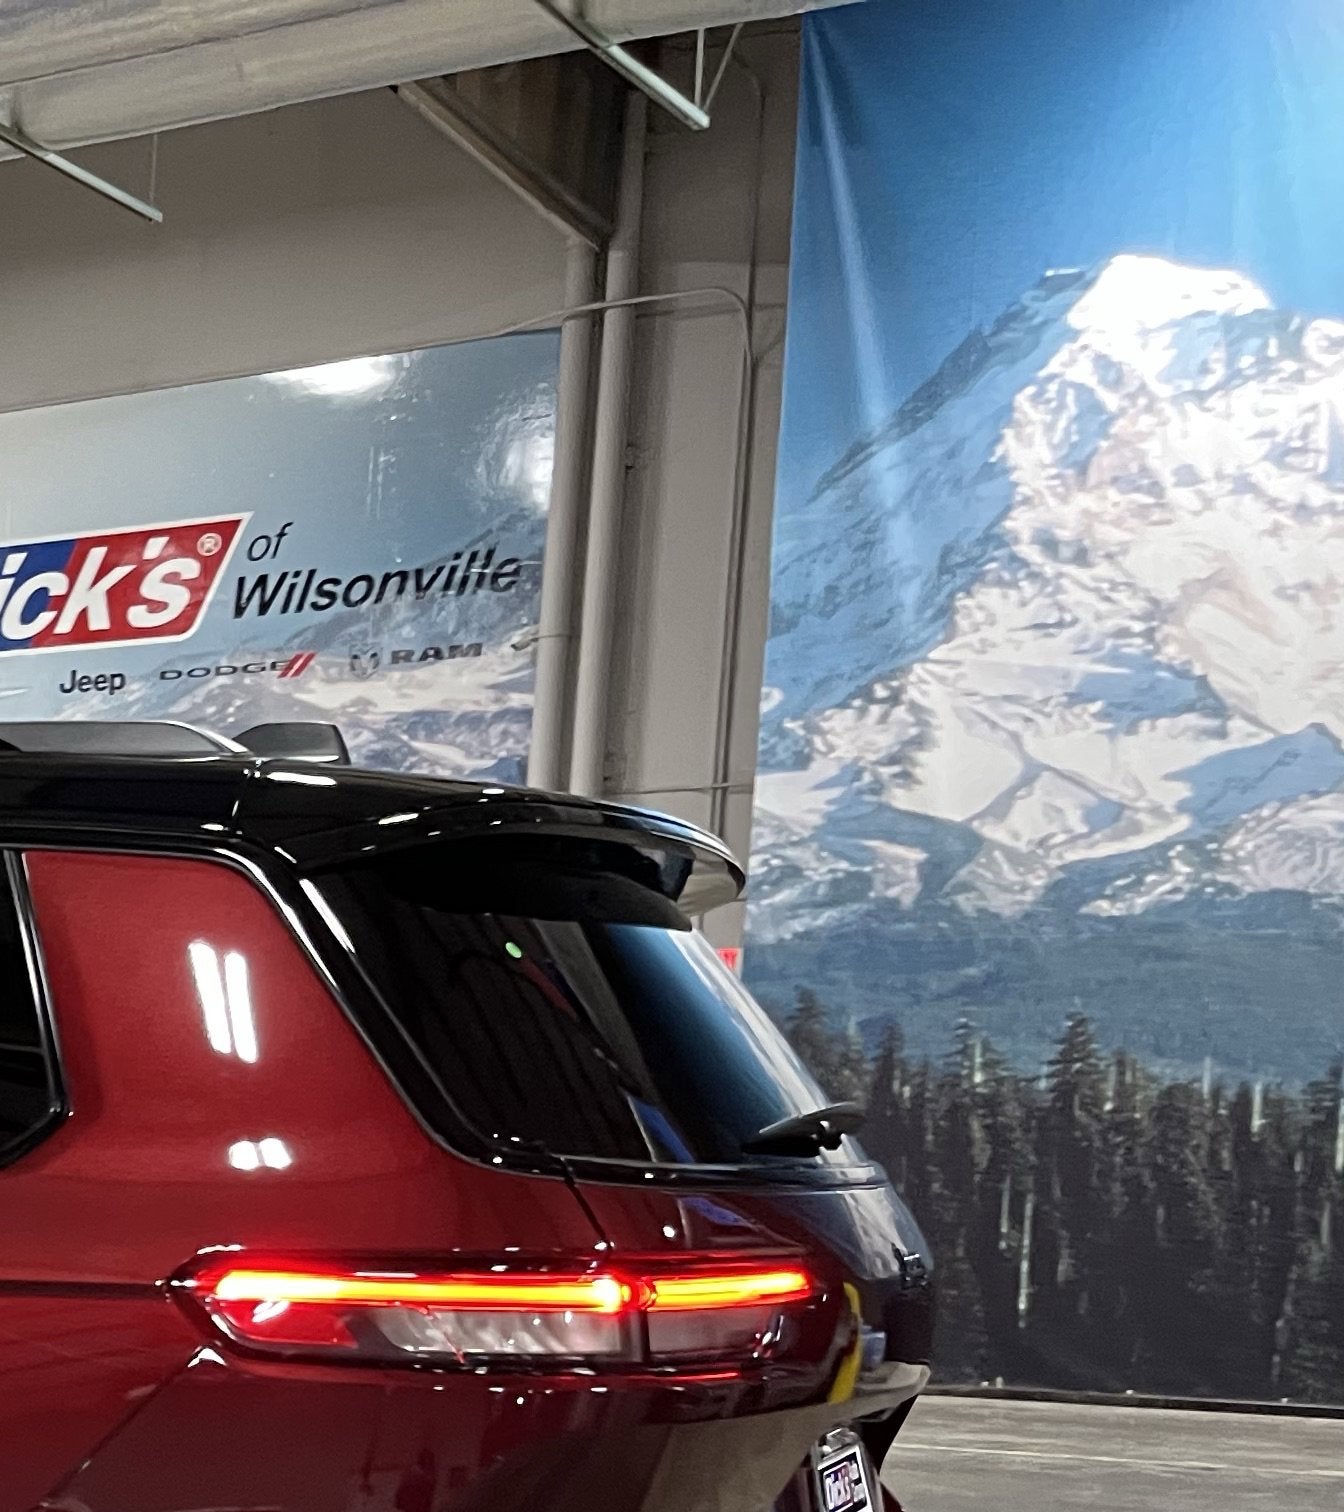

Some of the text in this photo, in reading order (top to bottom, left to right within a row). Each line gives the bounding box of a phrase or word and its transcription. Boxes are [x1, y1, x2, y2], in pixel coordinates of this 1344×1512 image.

[247, 521, 294, 562] of
[233, 545, 522, 620] Wilsonville
[390, 643, 483, 665] RAM
[59, 670, 127, 695] Jeep
[159, 660, 293, 681] DODGE
